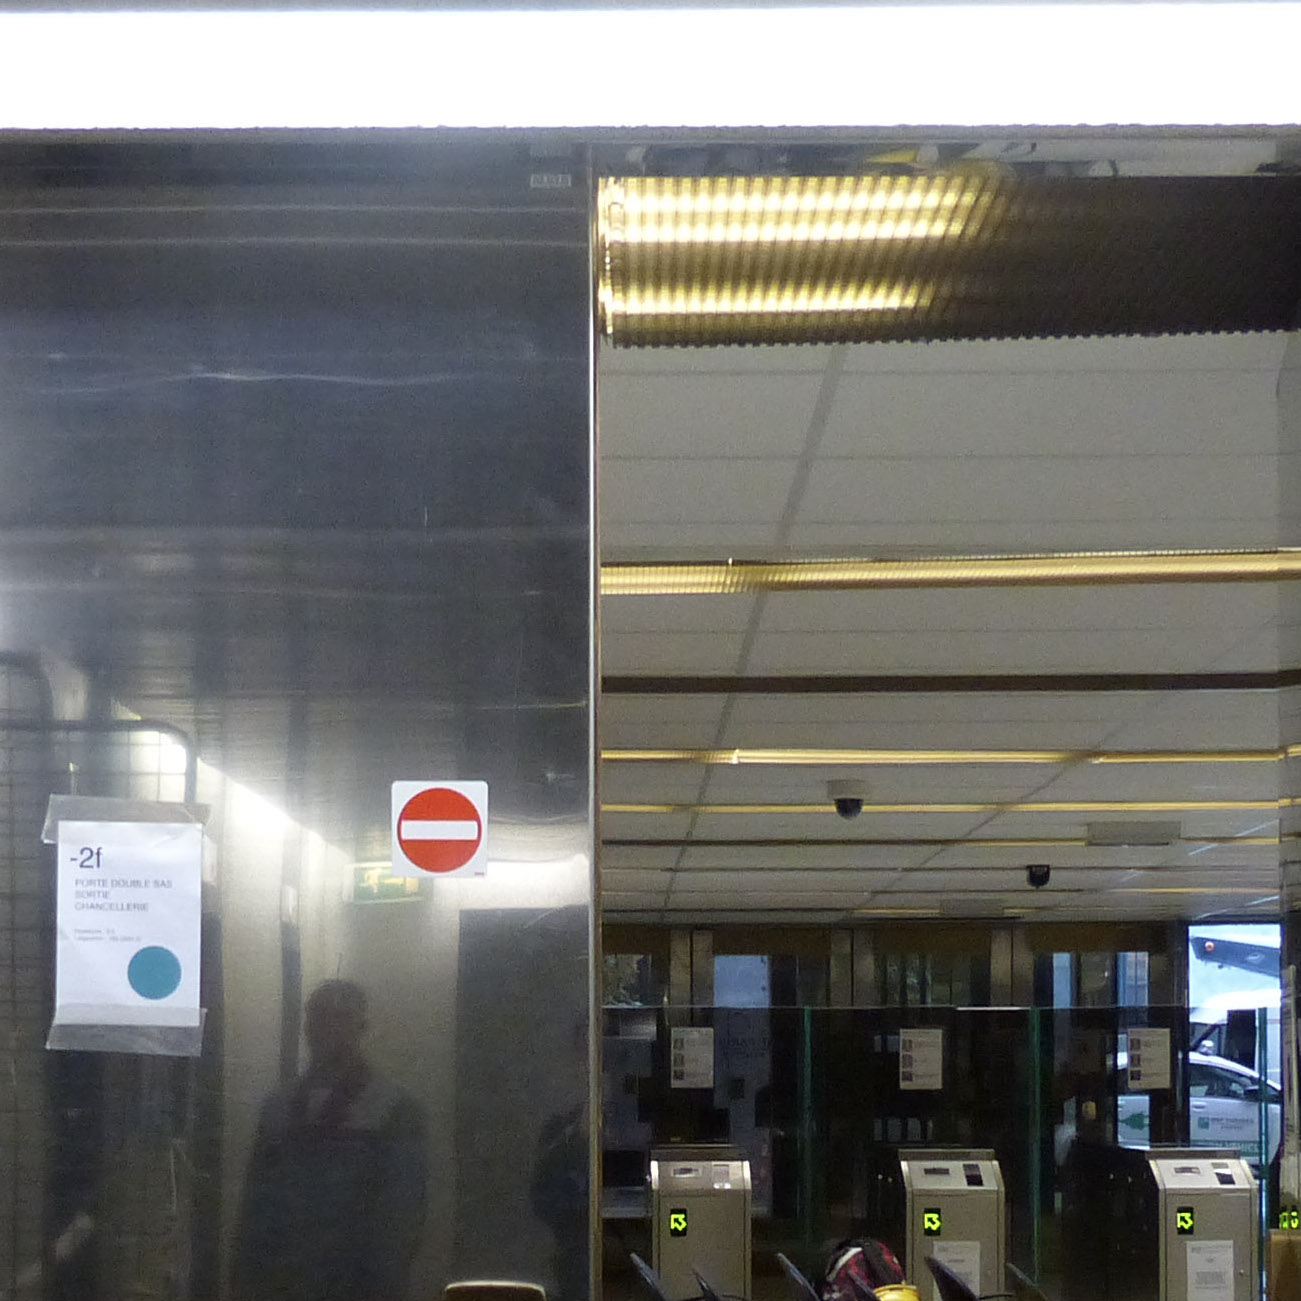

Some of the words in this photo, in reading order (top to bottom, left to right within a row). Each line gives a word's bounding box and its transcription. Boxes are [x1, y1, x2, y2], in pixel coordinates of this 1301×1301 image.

[70, 847, 102, 868] -2f
[75, 878, 107, 888] PORTE
[110, 878, 151, 888] DOUBLE
[153, 878, 173, 888] SAS
[74, 890, 110, 899] SORTIE
[74, 901, 149, 912] CHANCELLERIE
